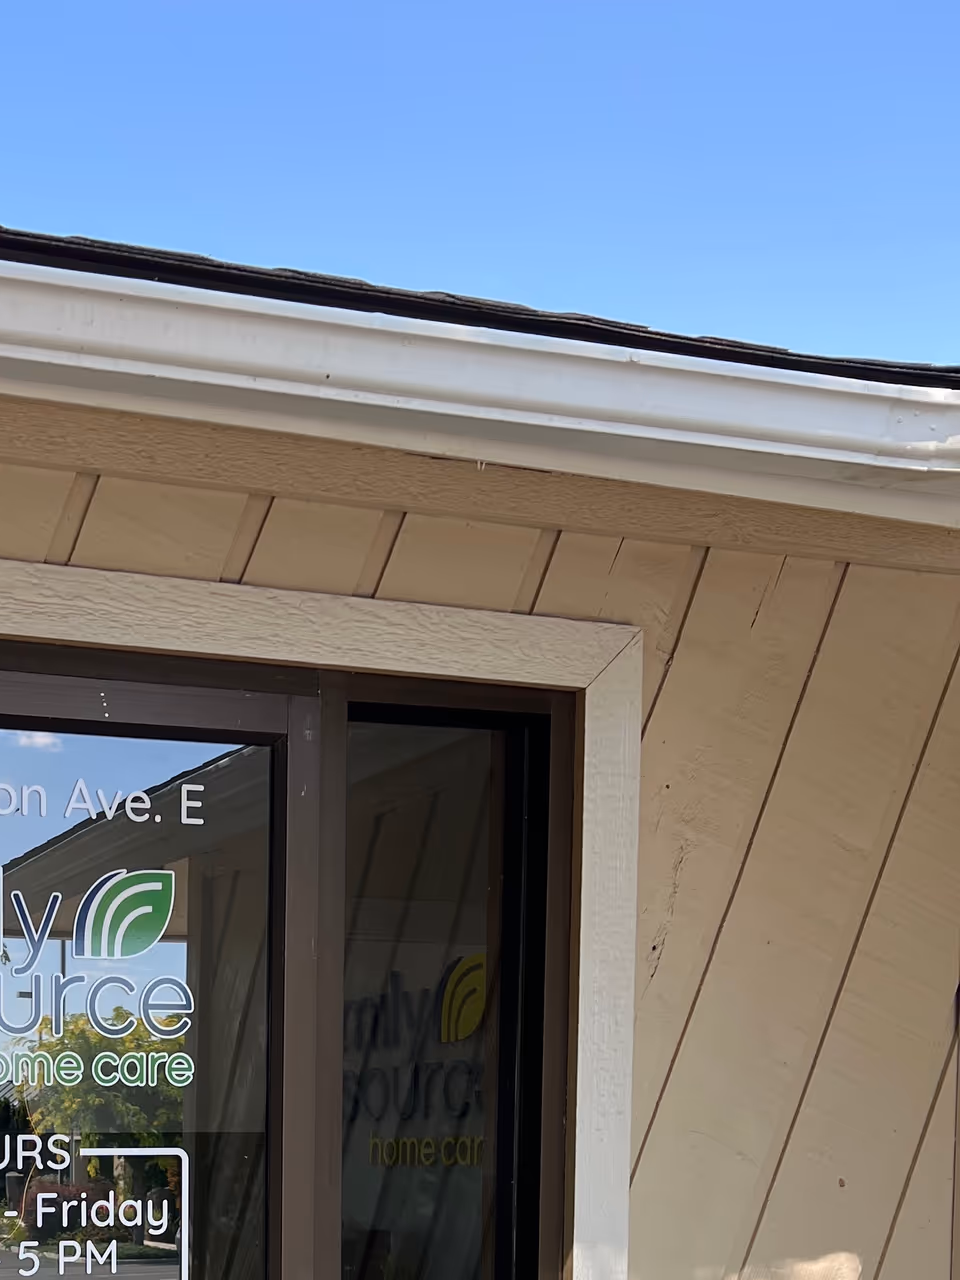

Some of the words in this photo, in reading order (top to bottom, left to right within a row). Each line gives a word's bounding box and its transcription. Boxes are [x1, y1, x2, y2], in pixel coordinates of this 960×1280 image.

[65, 778, 162, 824] Ave.
[181, 784, 205, 826] E
[91, 1051, 195, 1087] care
[36, 1189, 169, 1235] Friday
[17, 1240, 40, 1277] 5
[57, 1239, 119, 1275] PM
